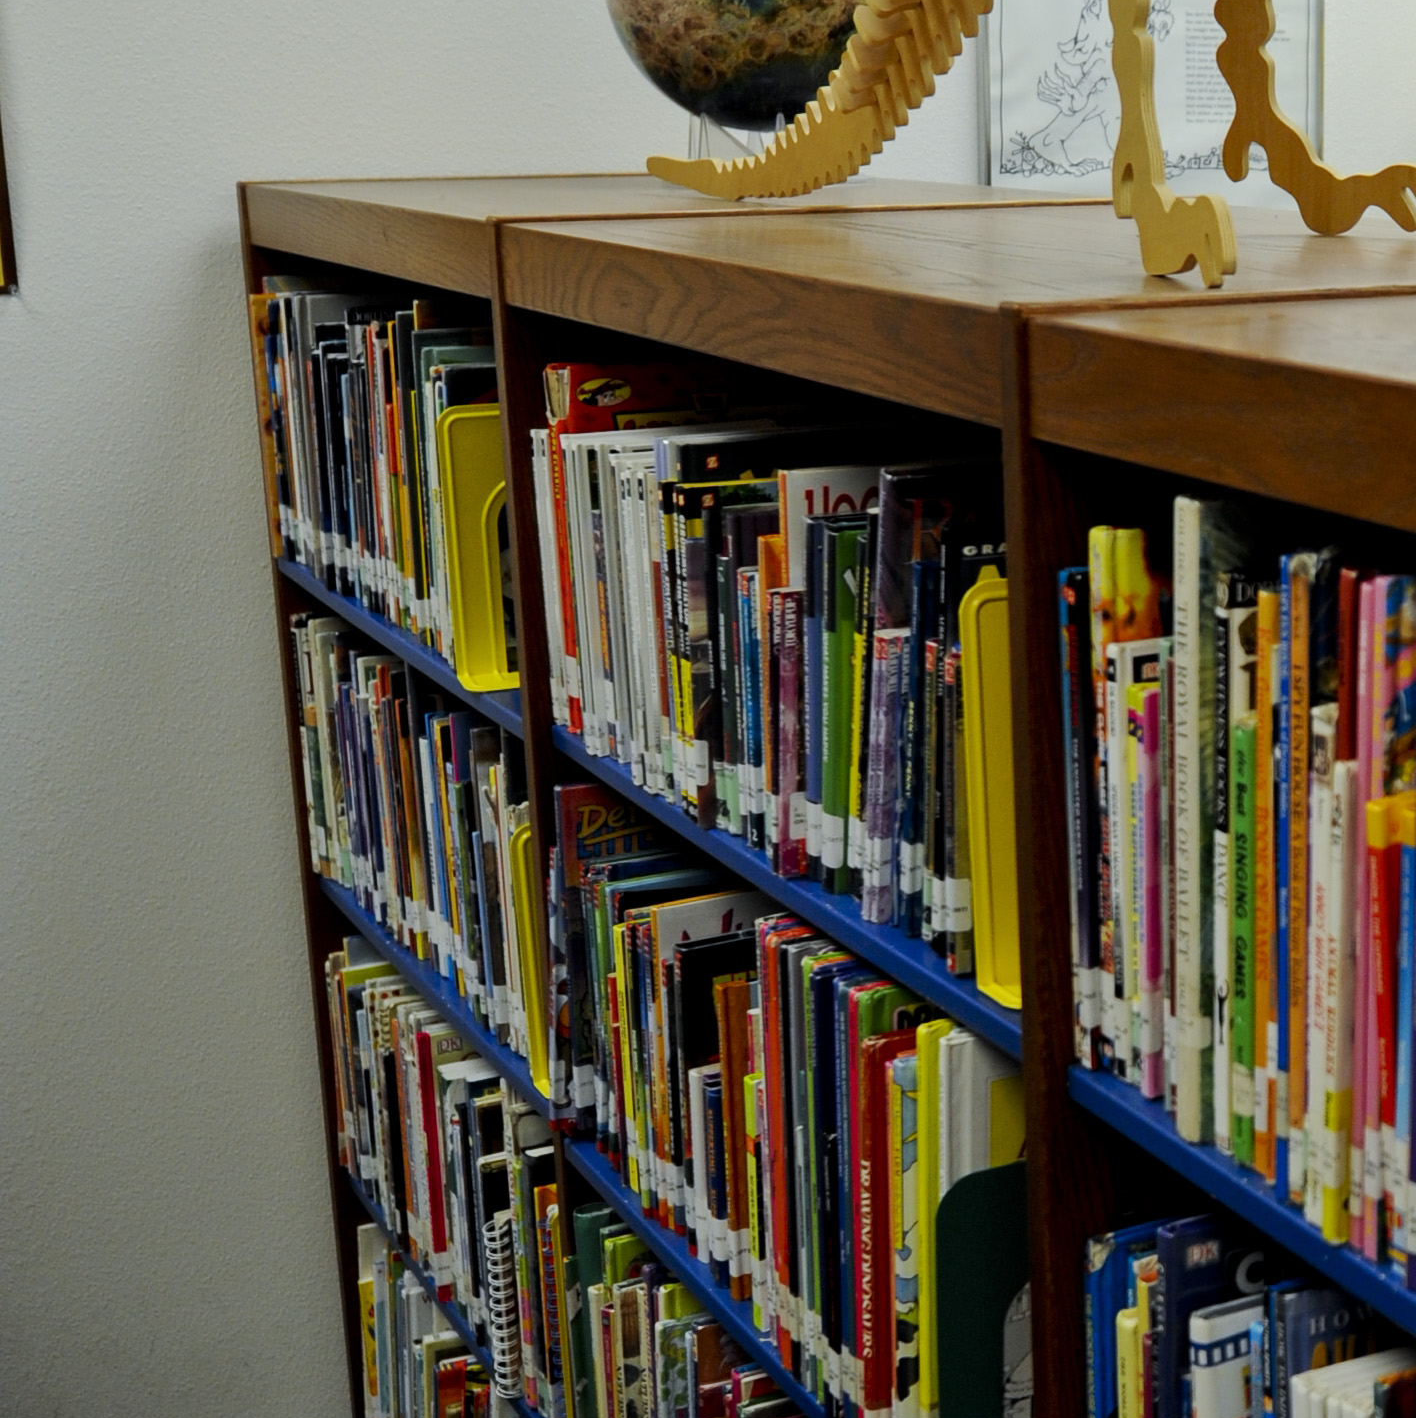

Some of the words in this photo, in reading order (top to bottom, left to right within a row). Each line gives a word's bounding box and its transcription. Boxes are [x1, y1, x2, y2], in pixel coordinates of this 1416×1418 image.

[1175, 601, 1188, 657] THE
[1176, 665, 1188, 741] ROYAL
[1215, 623, 1228, 750] EYEWITNESS
[1177, 755, 1189, 823] BOOK
[1215, 754, 1228, 826] BOOKS
[1236, 749, 1246, 777] the
[1236, 782, 1248, 818] Best
[1177, 829, 1189, 863] OF
[1216, 841, 1227, 909] DANCE
[1235, 831, 1248, 920] SINGING
[1178, 868, 1190, 963] BALLET
[1235, 935, 1247, 1000] GAMES
[860, 1159, 873, 1253] DRAWING
[861, 1253, 874, 1359] DINOSAURS
